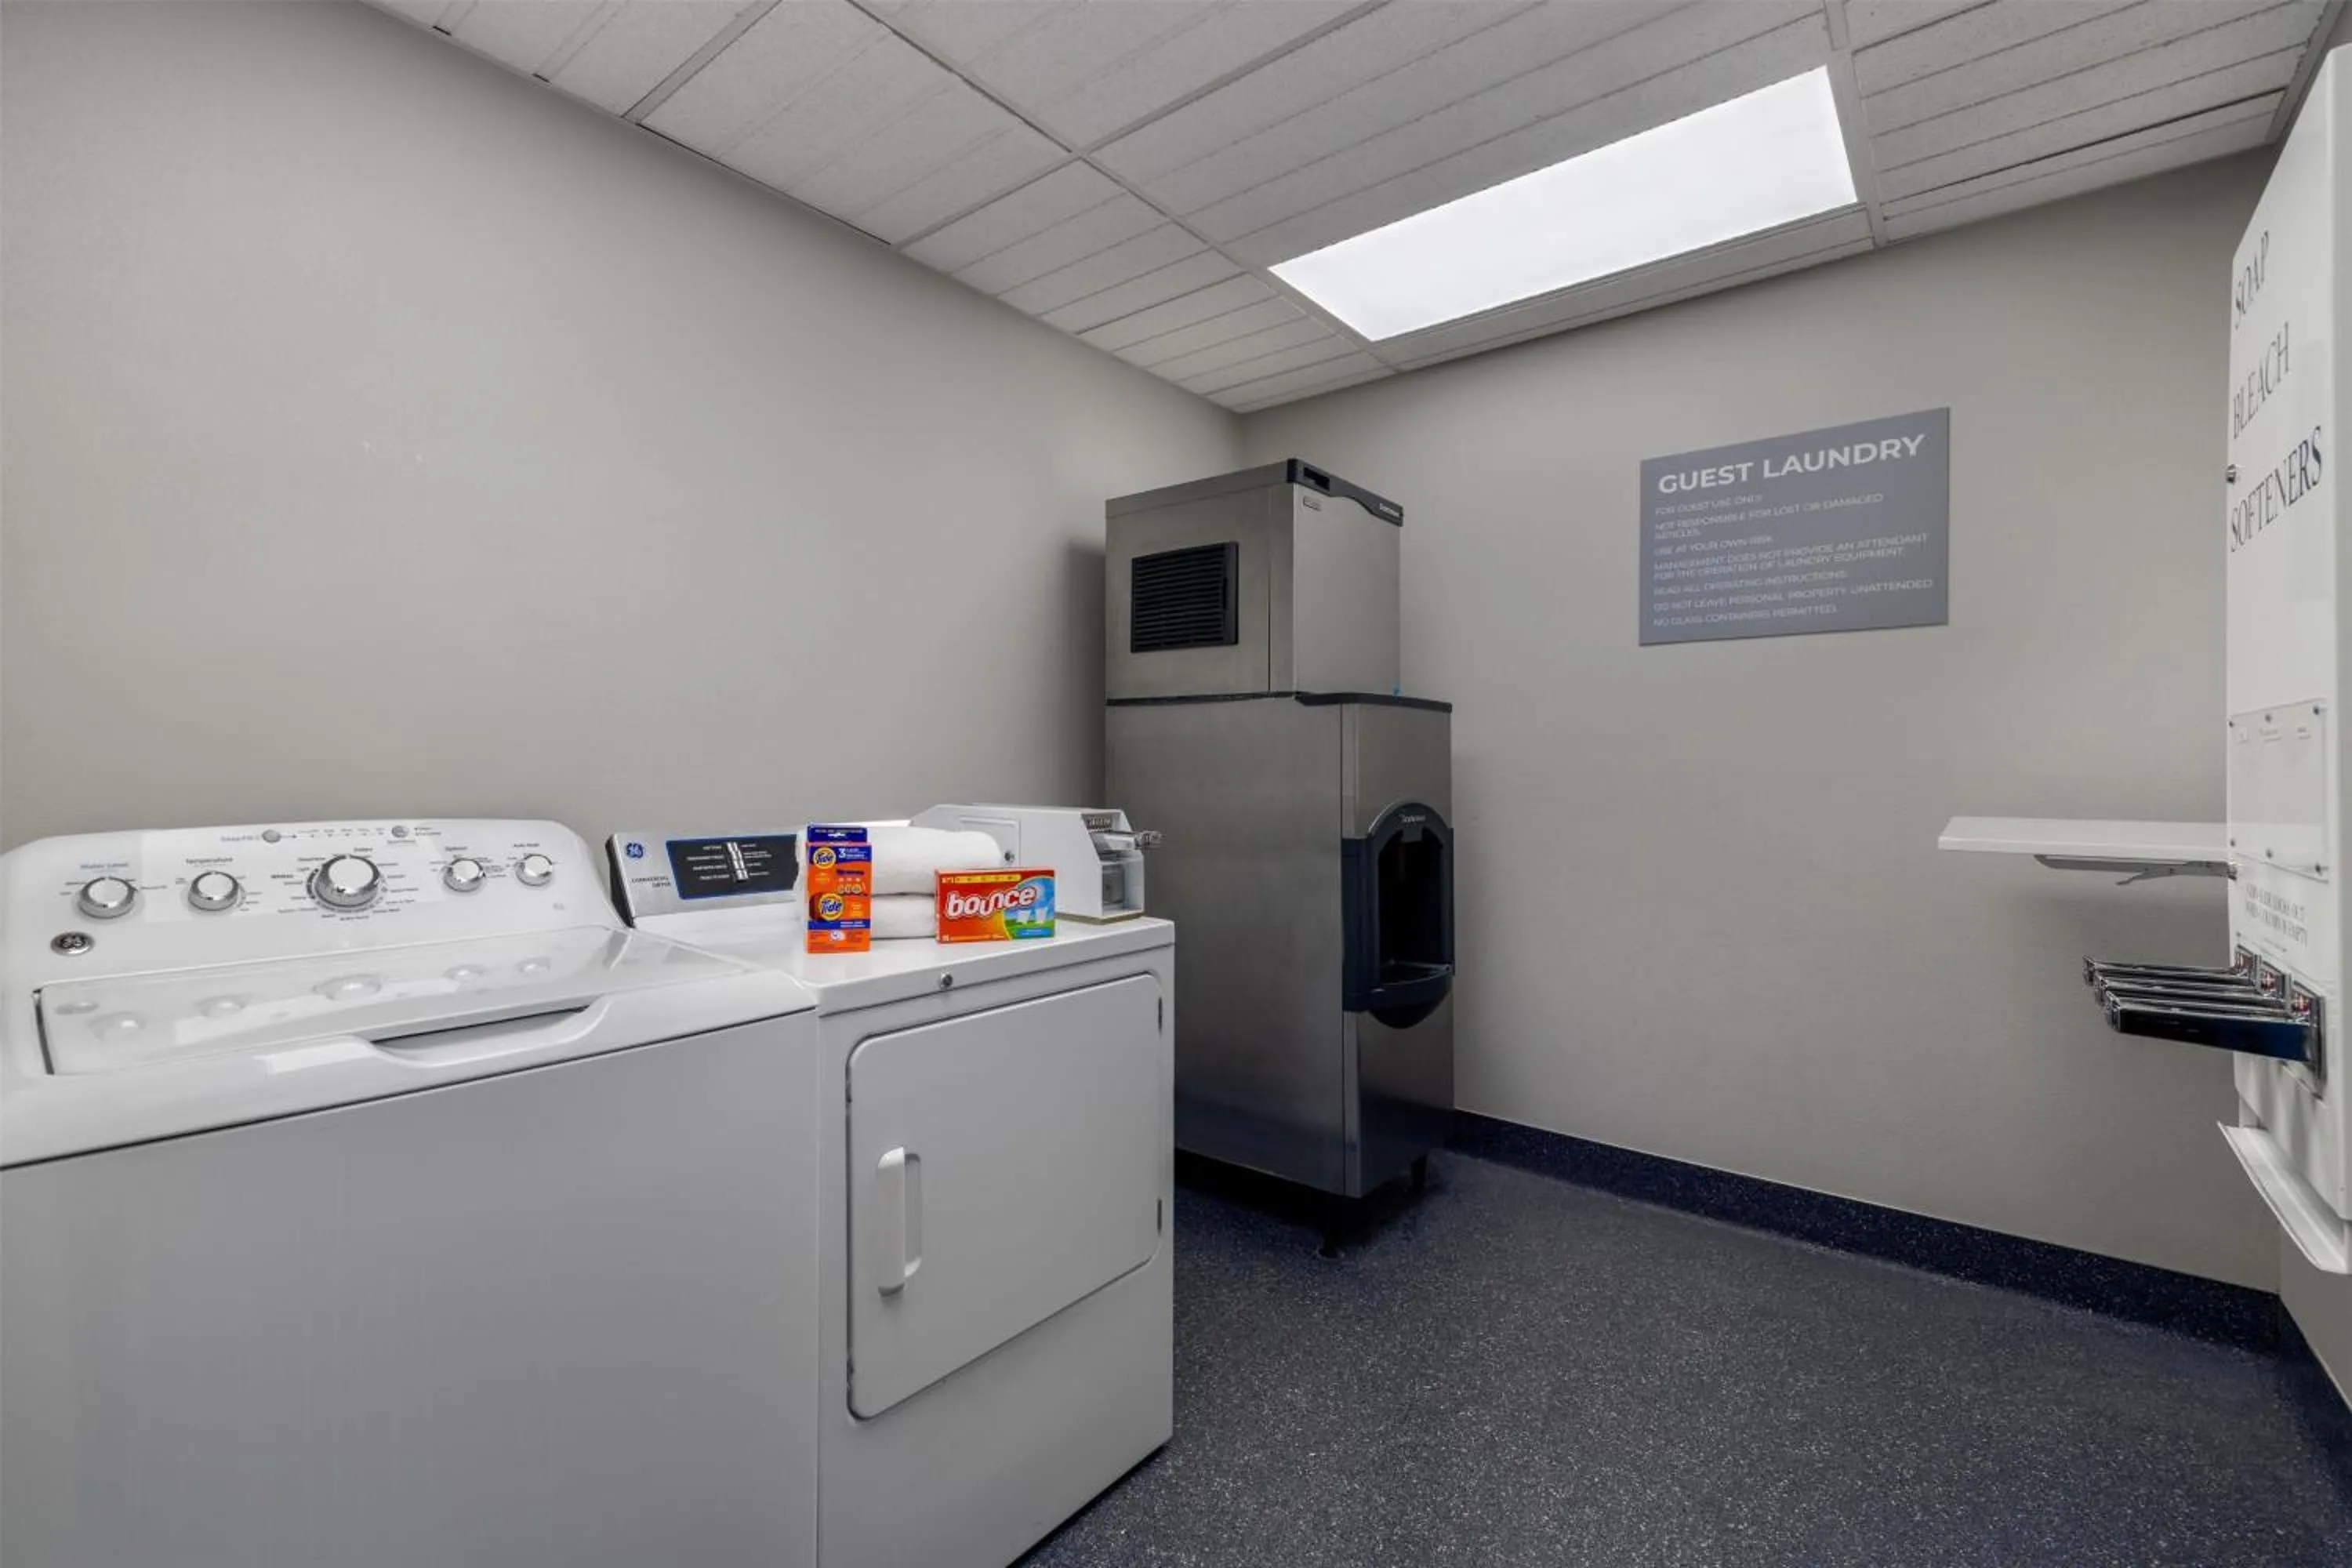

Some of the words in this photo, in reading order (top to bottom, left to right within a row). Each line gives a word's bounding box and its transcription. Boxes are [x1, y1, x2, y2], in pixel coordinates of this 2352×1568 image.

[2234, 230, 2270, 330] SOAP
[2233, 321, 2290, 441] BLEACH
[1658, 461, 1755, 494] GUEST
[1762, 433, 1926, 480] LAUNDRY
[2230, 425, 2323, 554] SOFTENERS
[1655, 507, 1675, 516] FOR
[1655, 521, 1674, 530] NOT
[1749, 509, 1771, 517] FOR
[1773, 503, 1799, 516] LOST
[1803, 502, 1821, 511] OR
[1690, 540, 1718, 552] YOUR
[1720, 539, 1747, 548] OWN
[1837, 543, 1854, 551] AN
[1654, 618, 1669, 626] NO
[821, 898, 842, 913] Tide
[946, 887, 1036, 918] bounce
